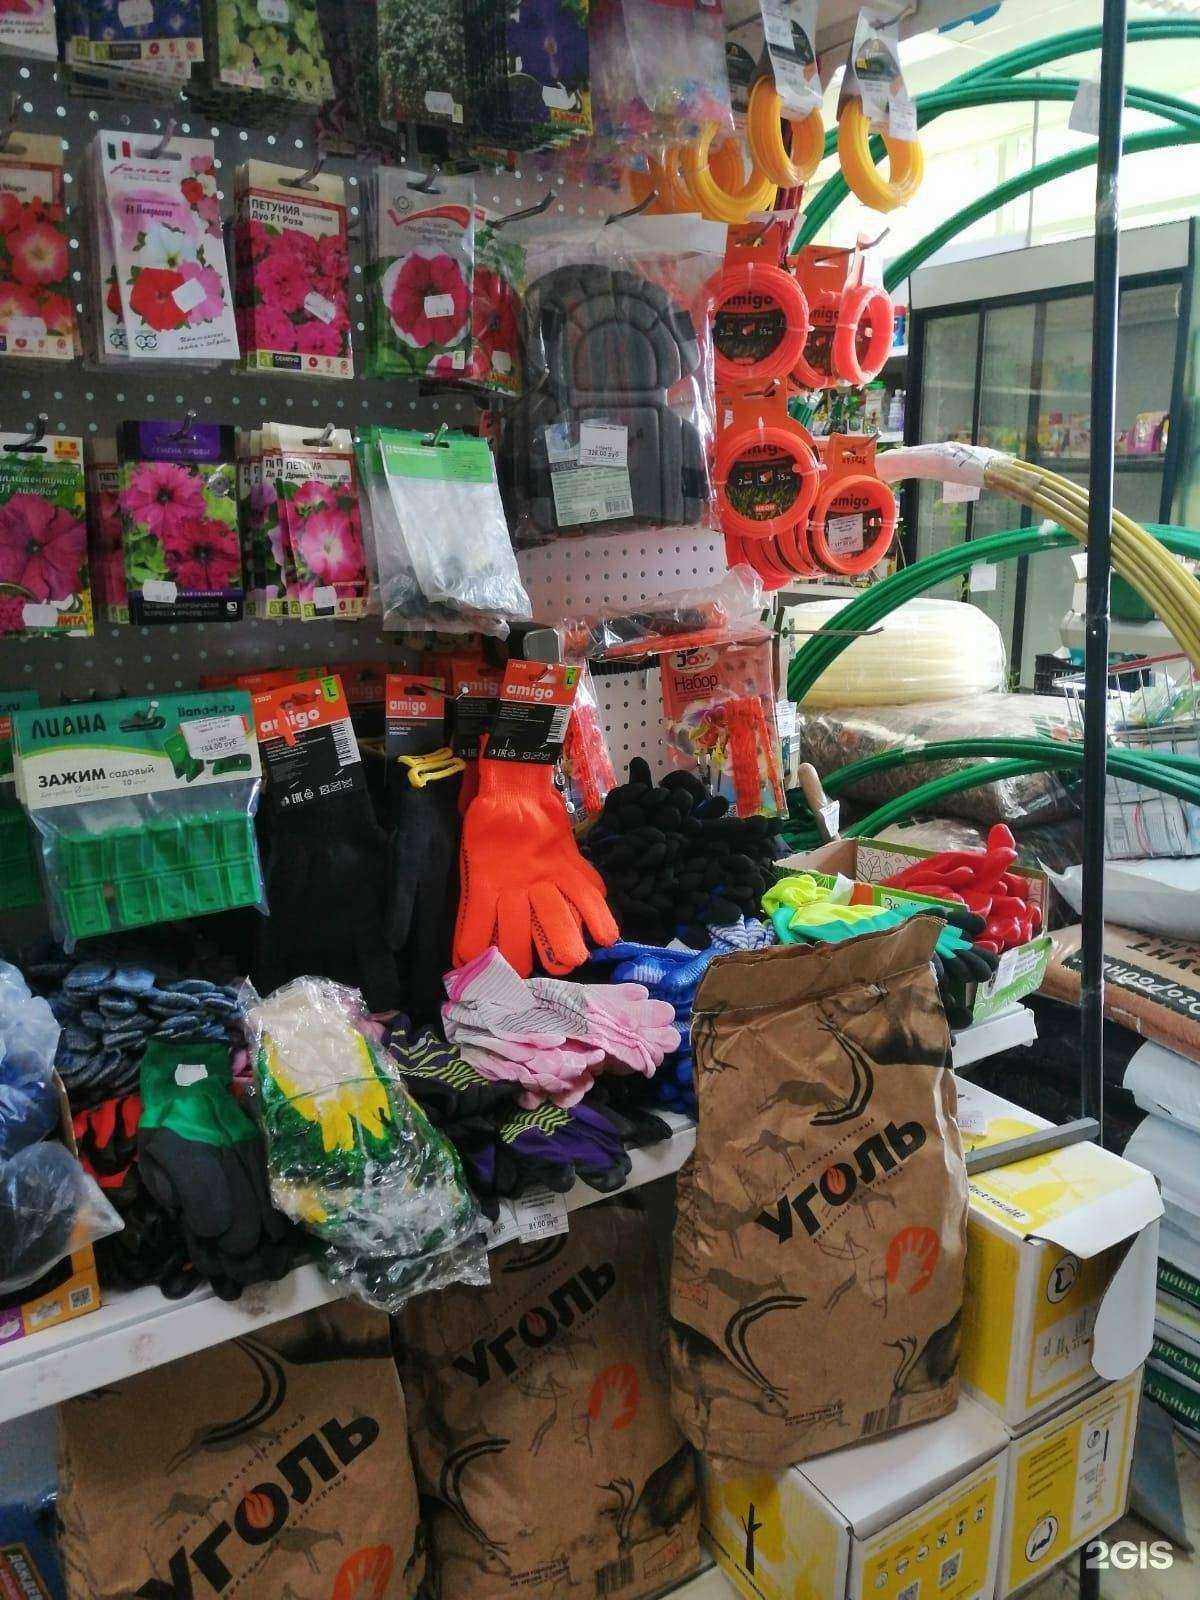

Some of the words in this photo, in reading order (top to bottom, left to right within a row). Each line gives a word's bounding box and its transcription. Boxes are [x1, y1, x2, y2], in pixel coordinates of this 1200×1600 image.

[252, 199, 300, 215] ПЕТУНИЯ
[507, 682, 554, 701] amigo
[674, 674, 718, 691] Набор
[390, 697, 427, 716] amigo
[31, 713, 107, 740] ЛИАНА
[38, 767, 106, 788] ЗАЖИМ
[755, 1121, 927, 1244] УГОЛЬ
[452, 1262, 616, 1387] УГОЛЬ
[136, 1415, 380, 1600] УГОЛЬ
